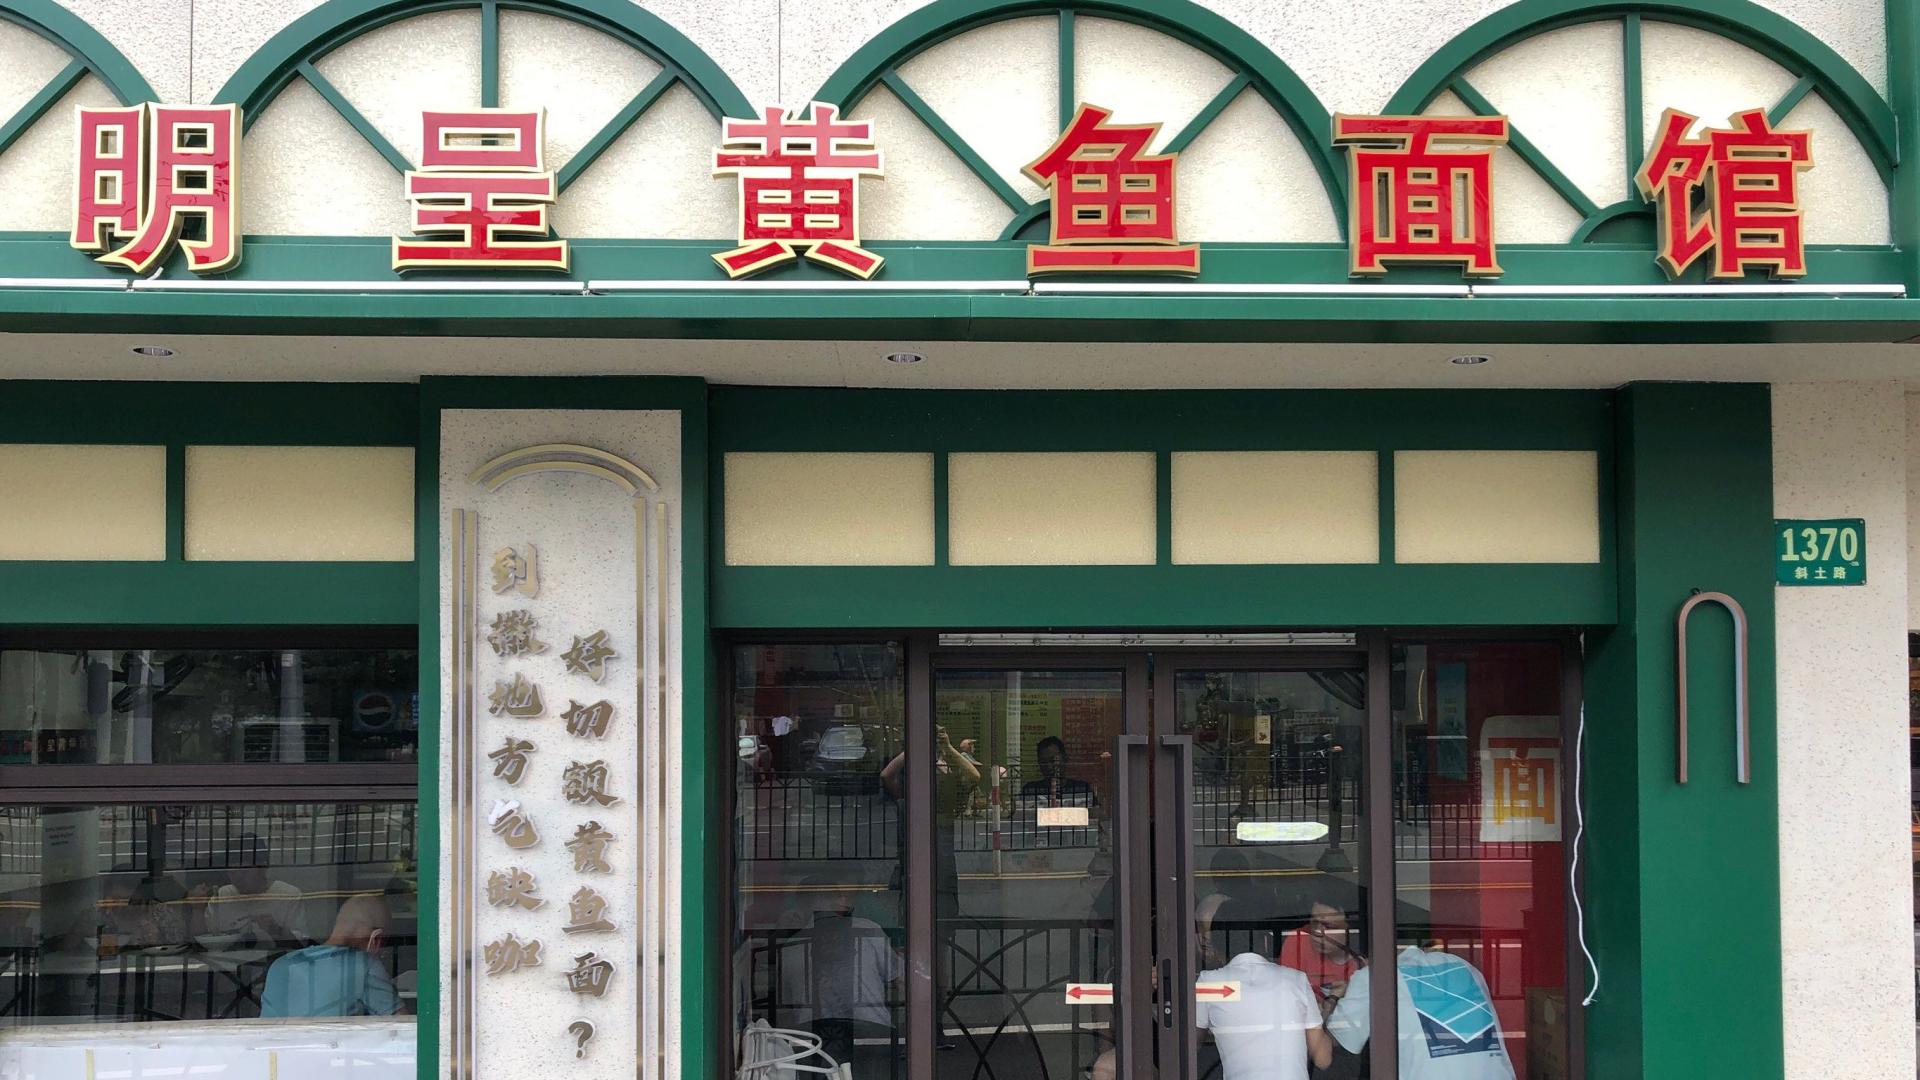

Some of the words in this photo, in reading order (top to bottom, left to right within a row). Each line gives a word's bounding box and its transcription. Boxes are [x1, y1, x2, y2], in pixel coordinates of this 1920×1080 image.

[70, 102, 1814, 280] 明呈黄鱼面馆
[1782, 527, 1858, 561] 1370
[1794, 566, 1847, 579] 斜土路
